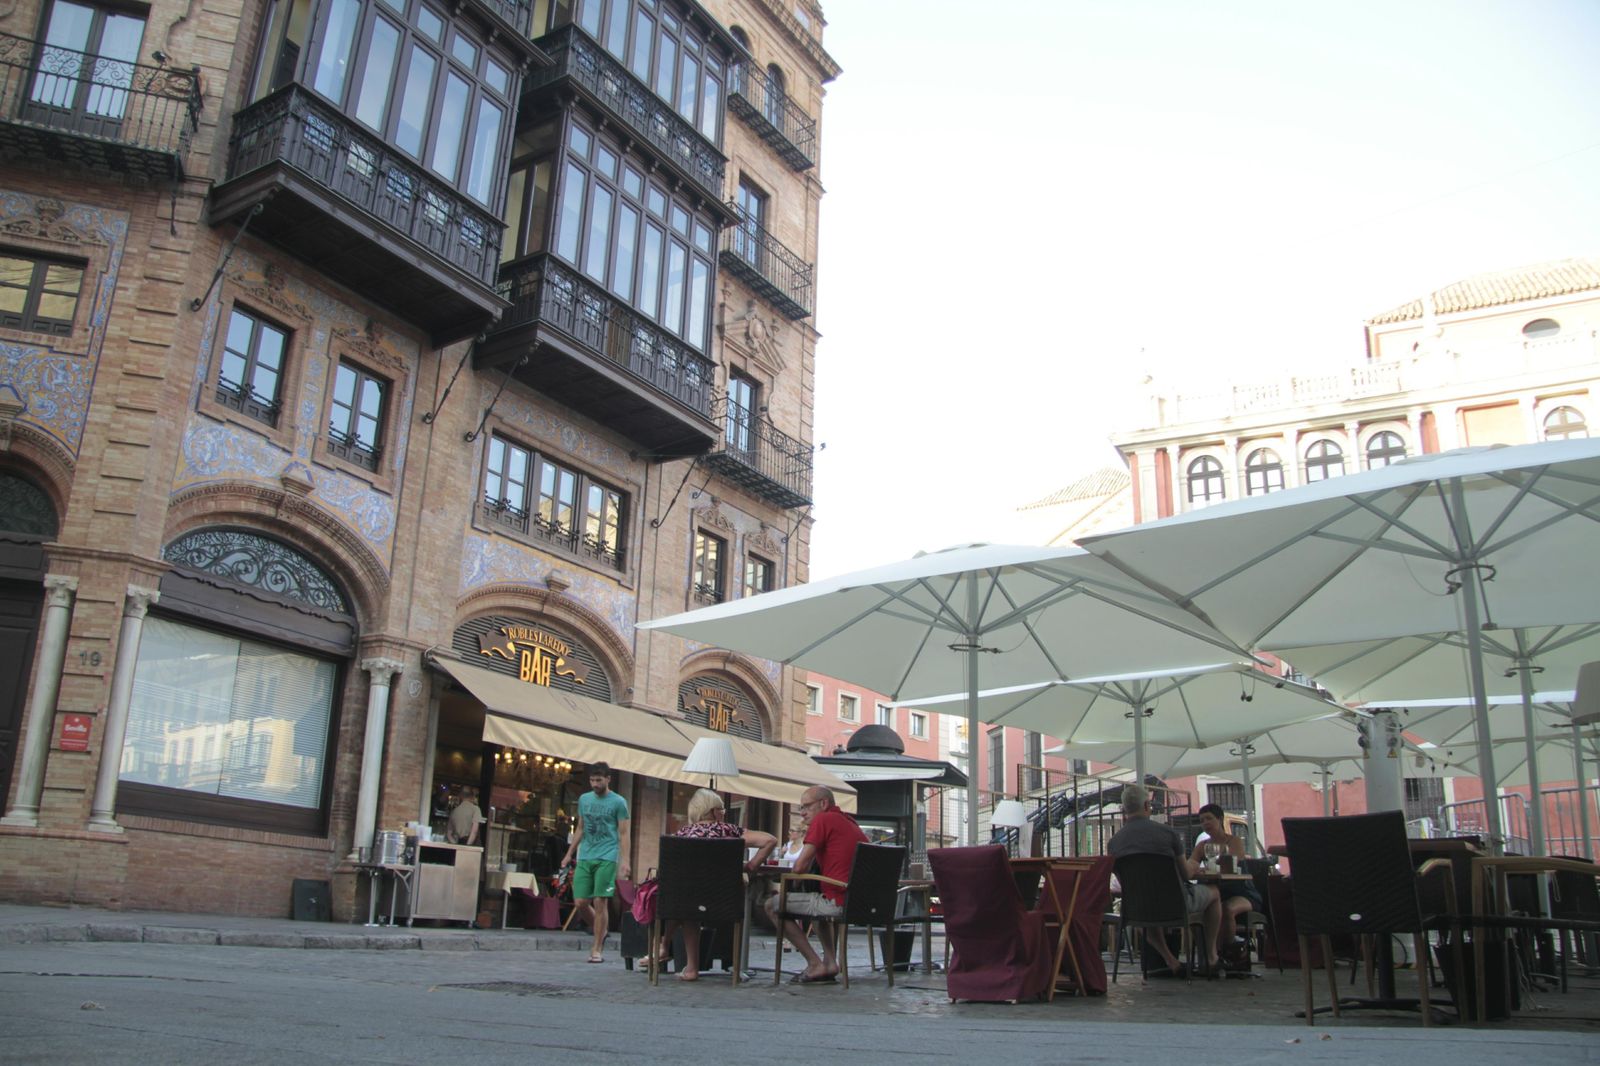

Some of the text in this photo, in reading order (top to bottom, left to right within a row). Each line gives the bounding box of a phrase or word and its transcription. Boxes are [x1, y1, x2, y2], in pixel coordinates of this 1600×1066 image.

[508, 626, 570, 657] ROBLES LAREDO
[79, 651, 102, 667] 19
[520, 647, 551, 688] BAR
[710, 702, 729, 733] BAR
